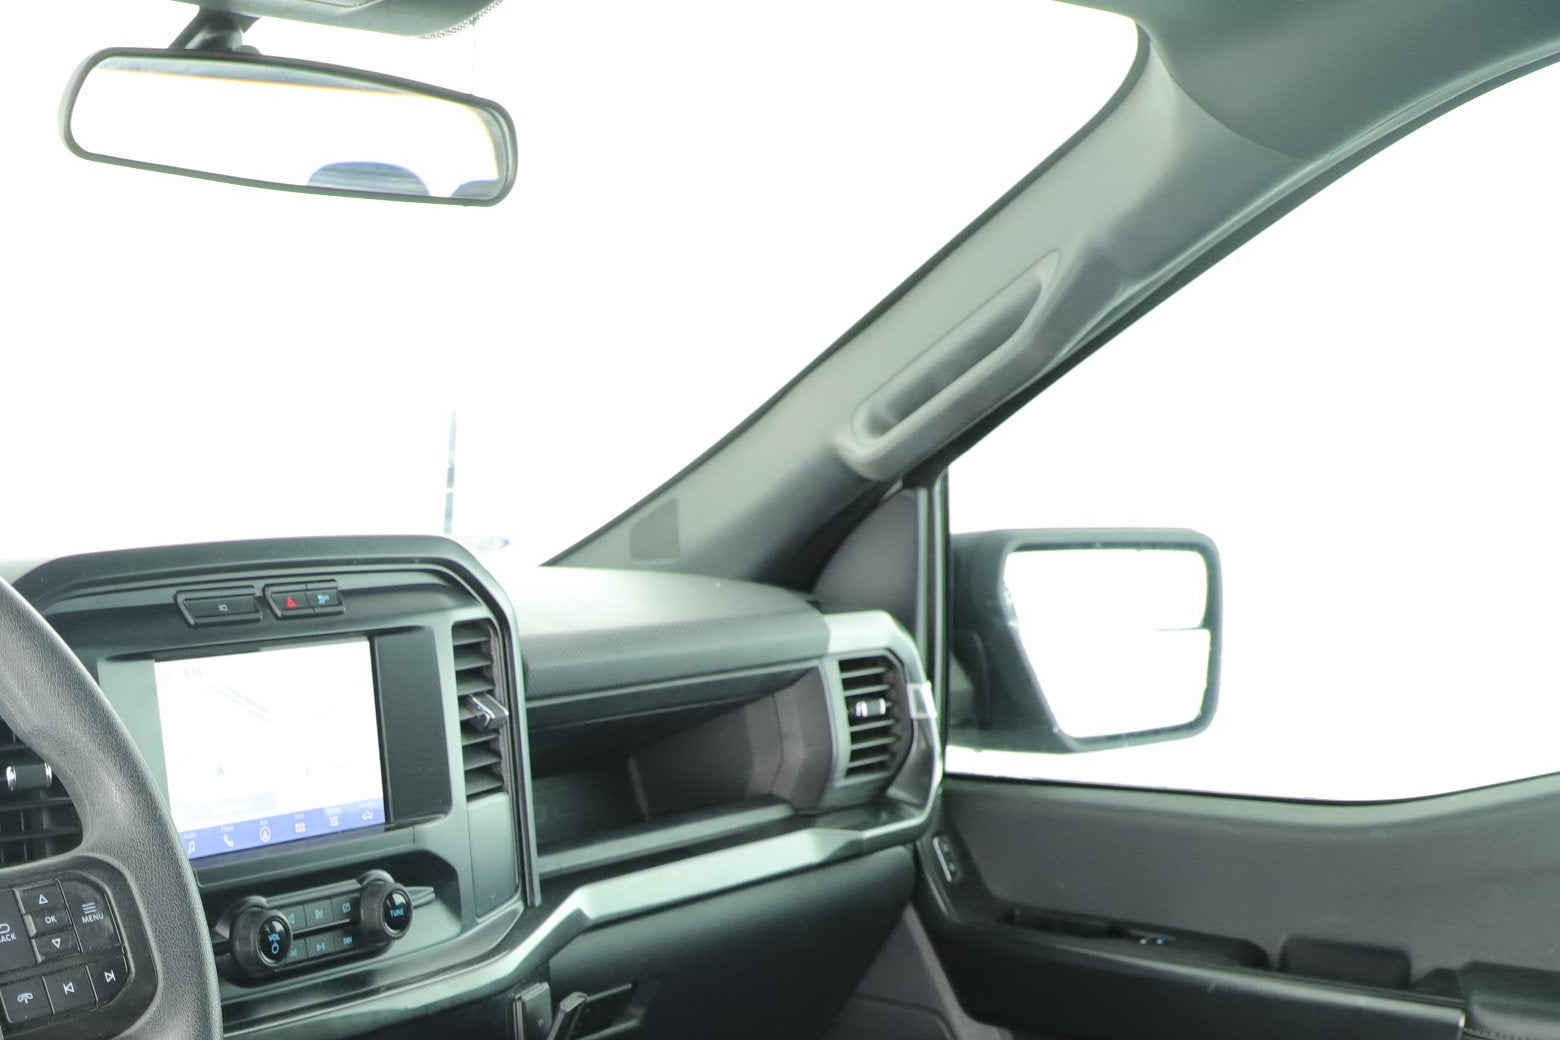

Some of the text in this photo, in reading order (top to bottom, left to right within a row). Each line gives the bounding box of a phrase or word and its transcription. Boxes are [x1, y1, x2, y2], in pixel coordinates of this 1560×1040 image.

[390, 908, 404, 917] TUNE
[44, 914, 58, 924] OK
[81, 912, 104, 924] MENU
[268, 932, 280, 942] VOL
